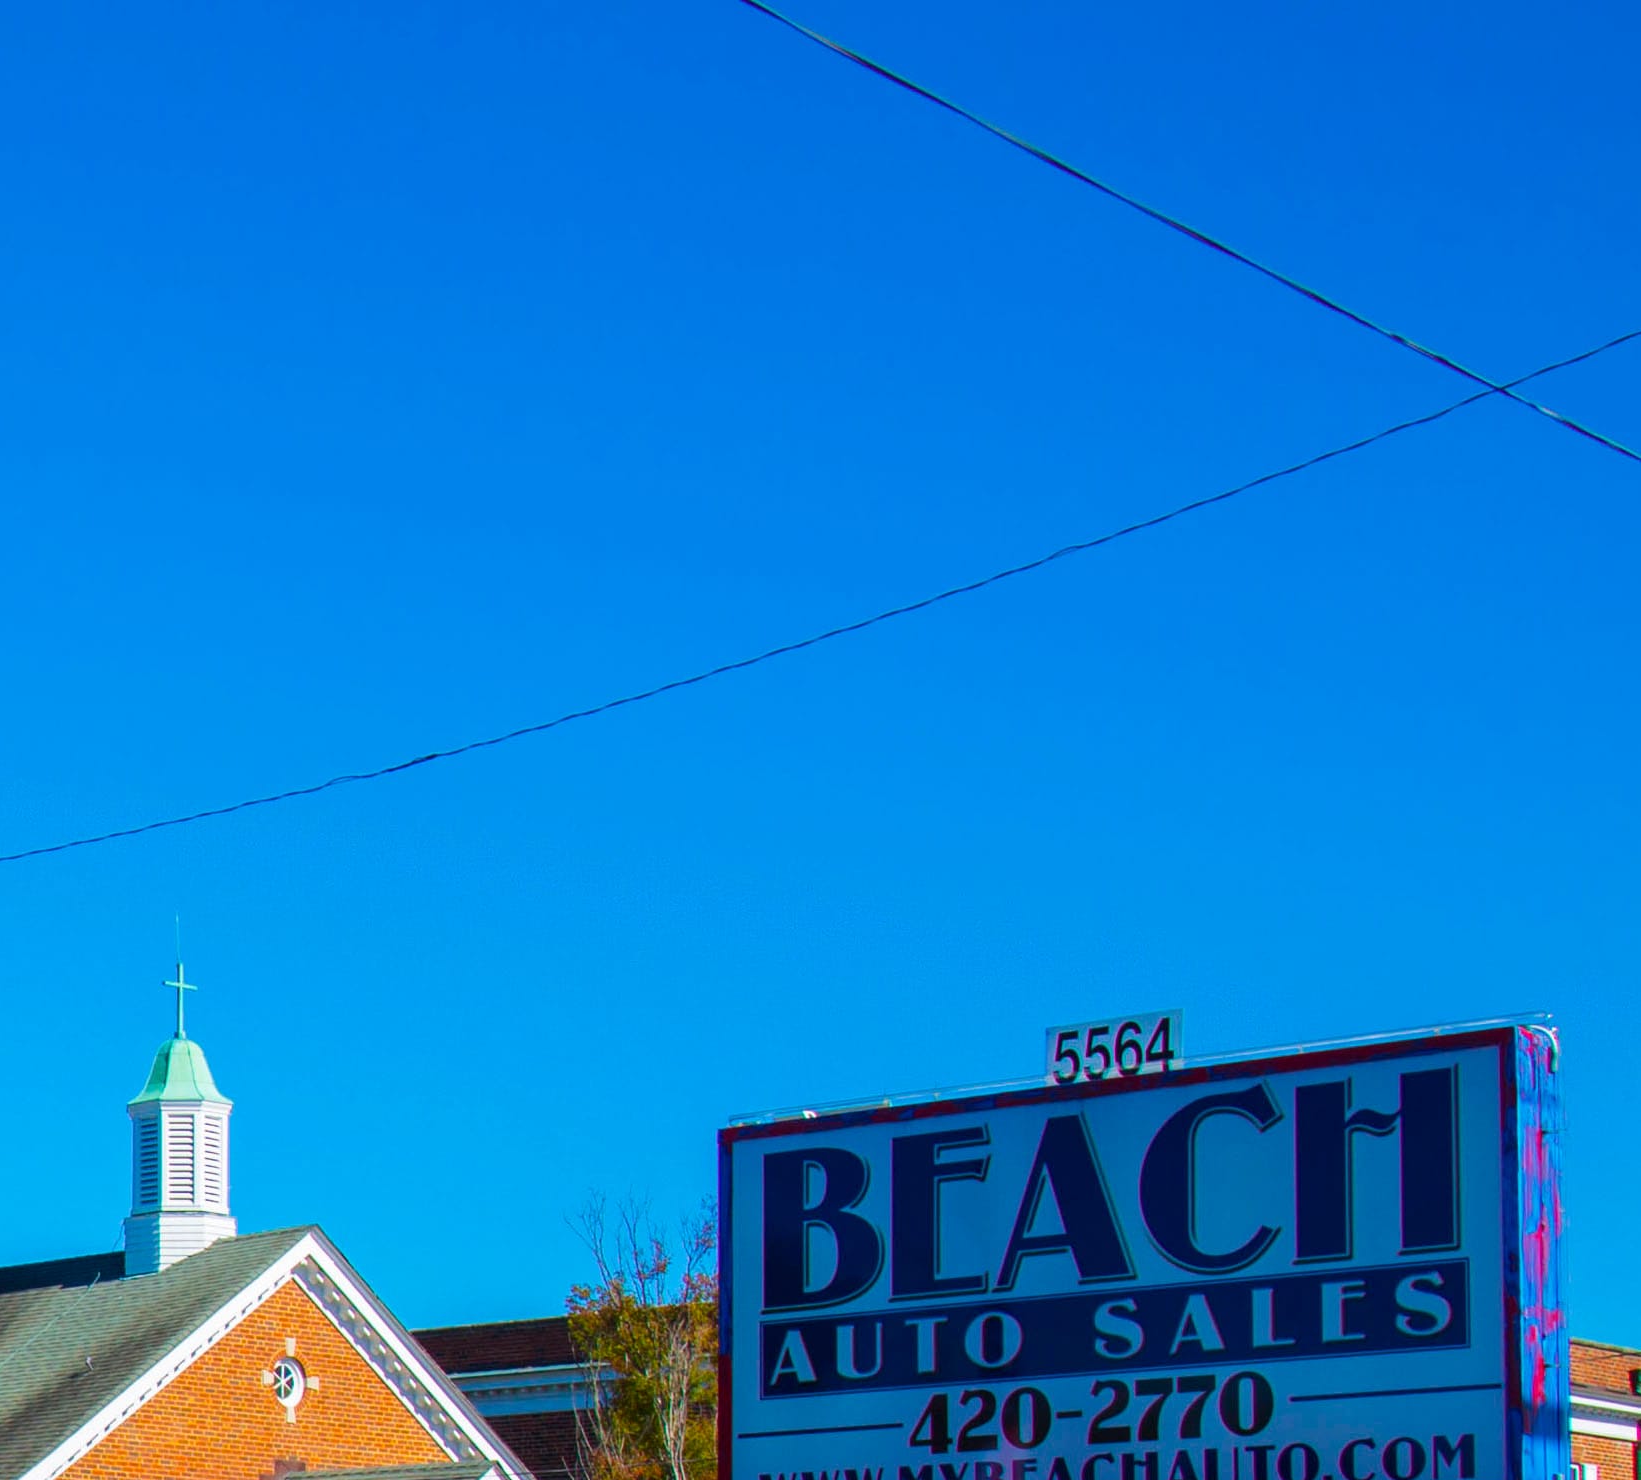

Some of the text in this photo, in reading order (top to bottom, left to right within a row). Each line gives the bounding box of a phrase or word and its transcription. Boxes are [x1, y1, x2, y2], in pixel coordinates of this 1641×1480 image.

[1053, 1017, 1175, 1085] 5564
[760, 1063, 1461, 1314] BEACH
[770, 1272, 1453, 1388] AUTO SALES
[909, 1368, 1274, 1455] 420-2770
